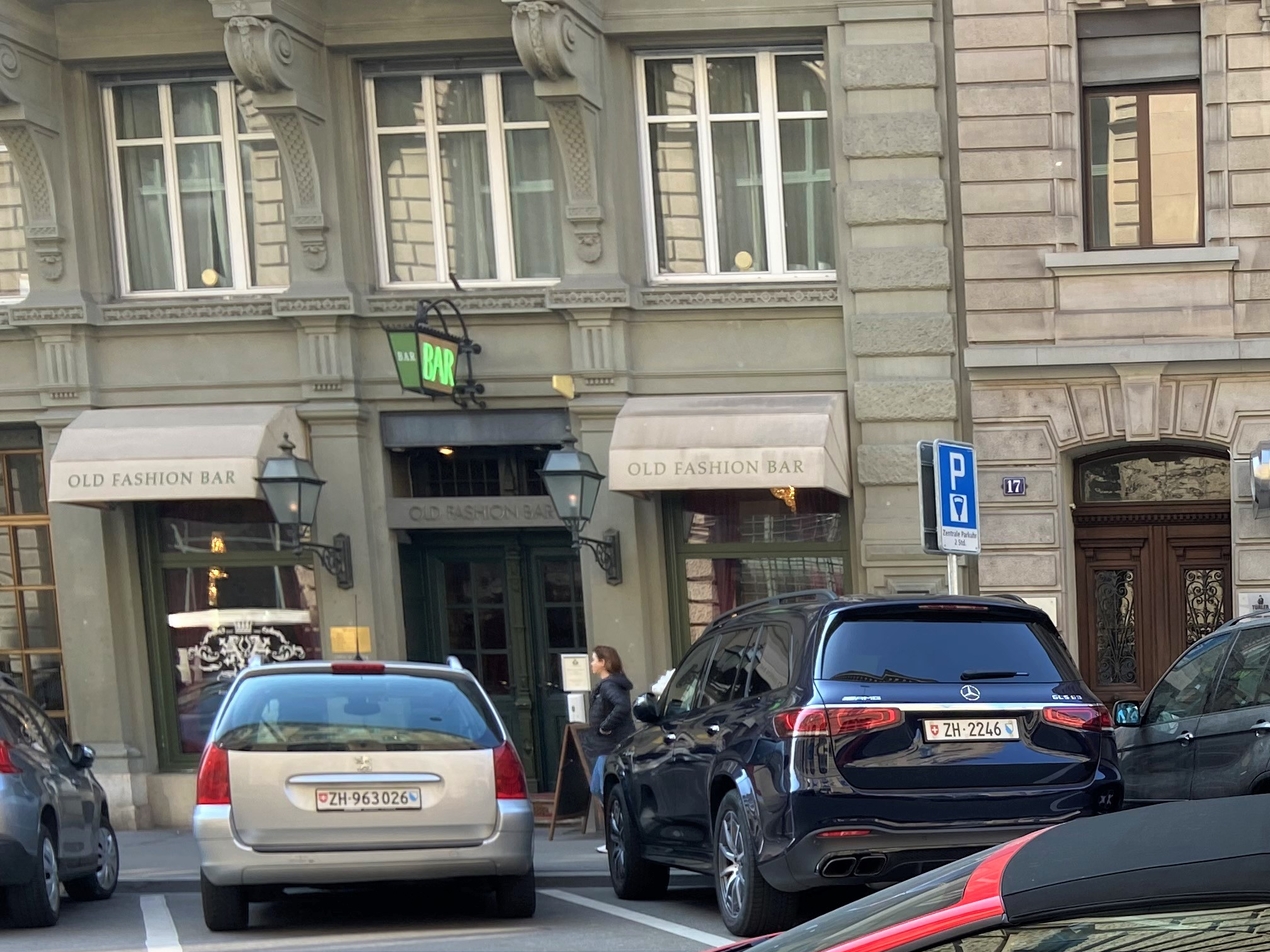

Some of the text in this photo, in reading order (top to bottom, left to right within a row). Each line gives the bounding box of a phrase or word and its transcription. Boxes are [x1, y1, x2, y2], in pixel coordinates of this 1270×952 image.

[397, 351, 416, 361] BAR
[422, 342, 454, 387] BAR
[627, 459, 804, 476] OLD FASHION BAR
[949, 452, 965, 490] P
[68, 470, 235, 488] OLD FASHION BAR
[1007, 480, 1021, 493] 17
[409, 503, 555, 522] OLD FASHION BAR
